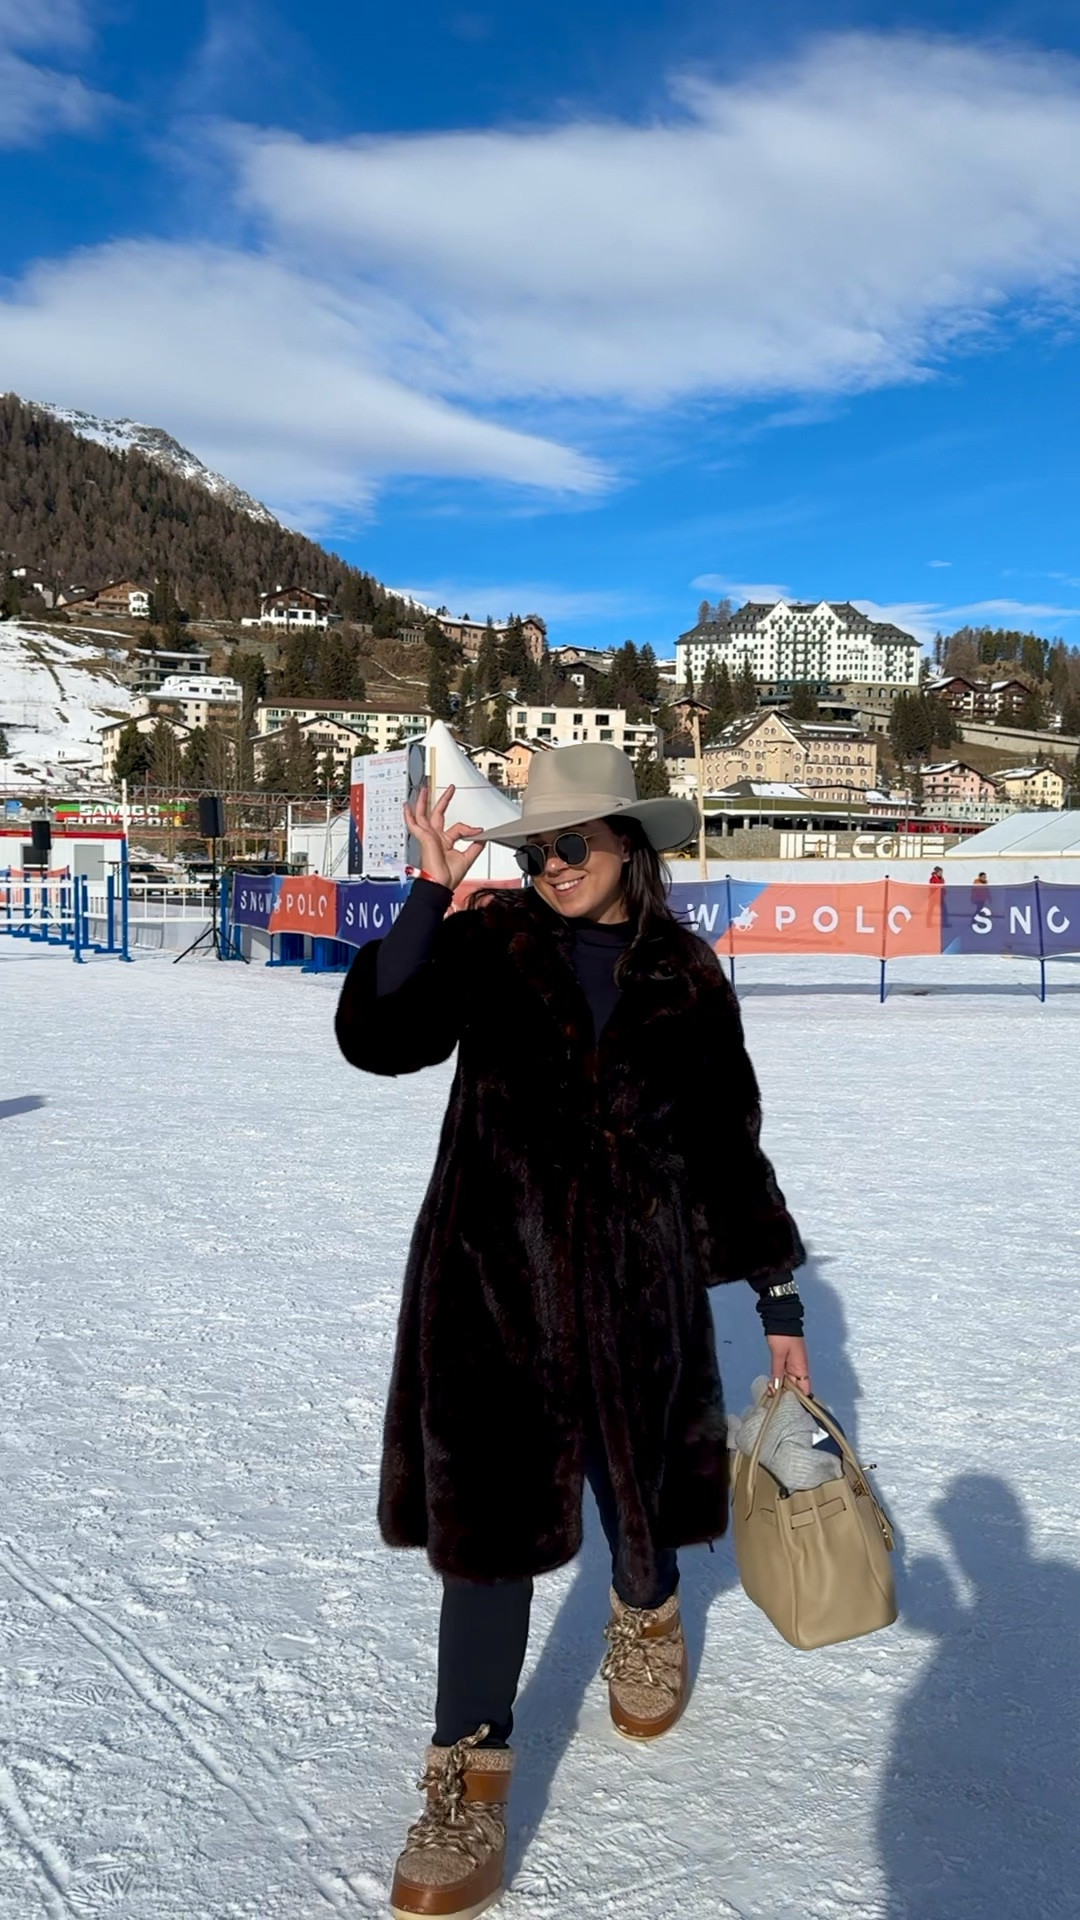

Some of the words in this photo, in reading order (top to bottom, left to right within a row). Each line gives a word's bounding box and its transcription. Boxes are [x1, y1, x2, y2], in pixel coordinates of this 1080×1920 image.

[79, 804, 160, 816] SAMIGO
[285, 893, 328, 918] POLO
[774, 904, 913, 935] POLO
[970, 904, 1071, 936] SNO
